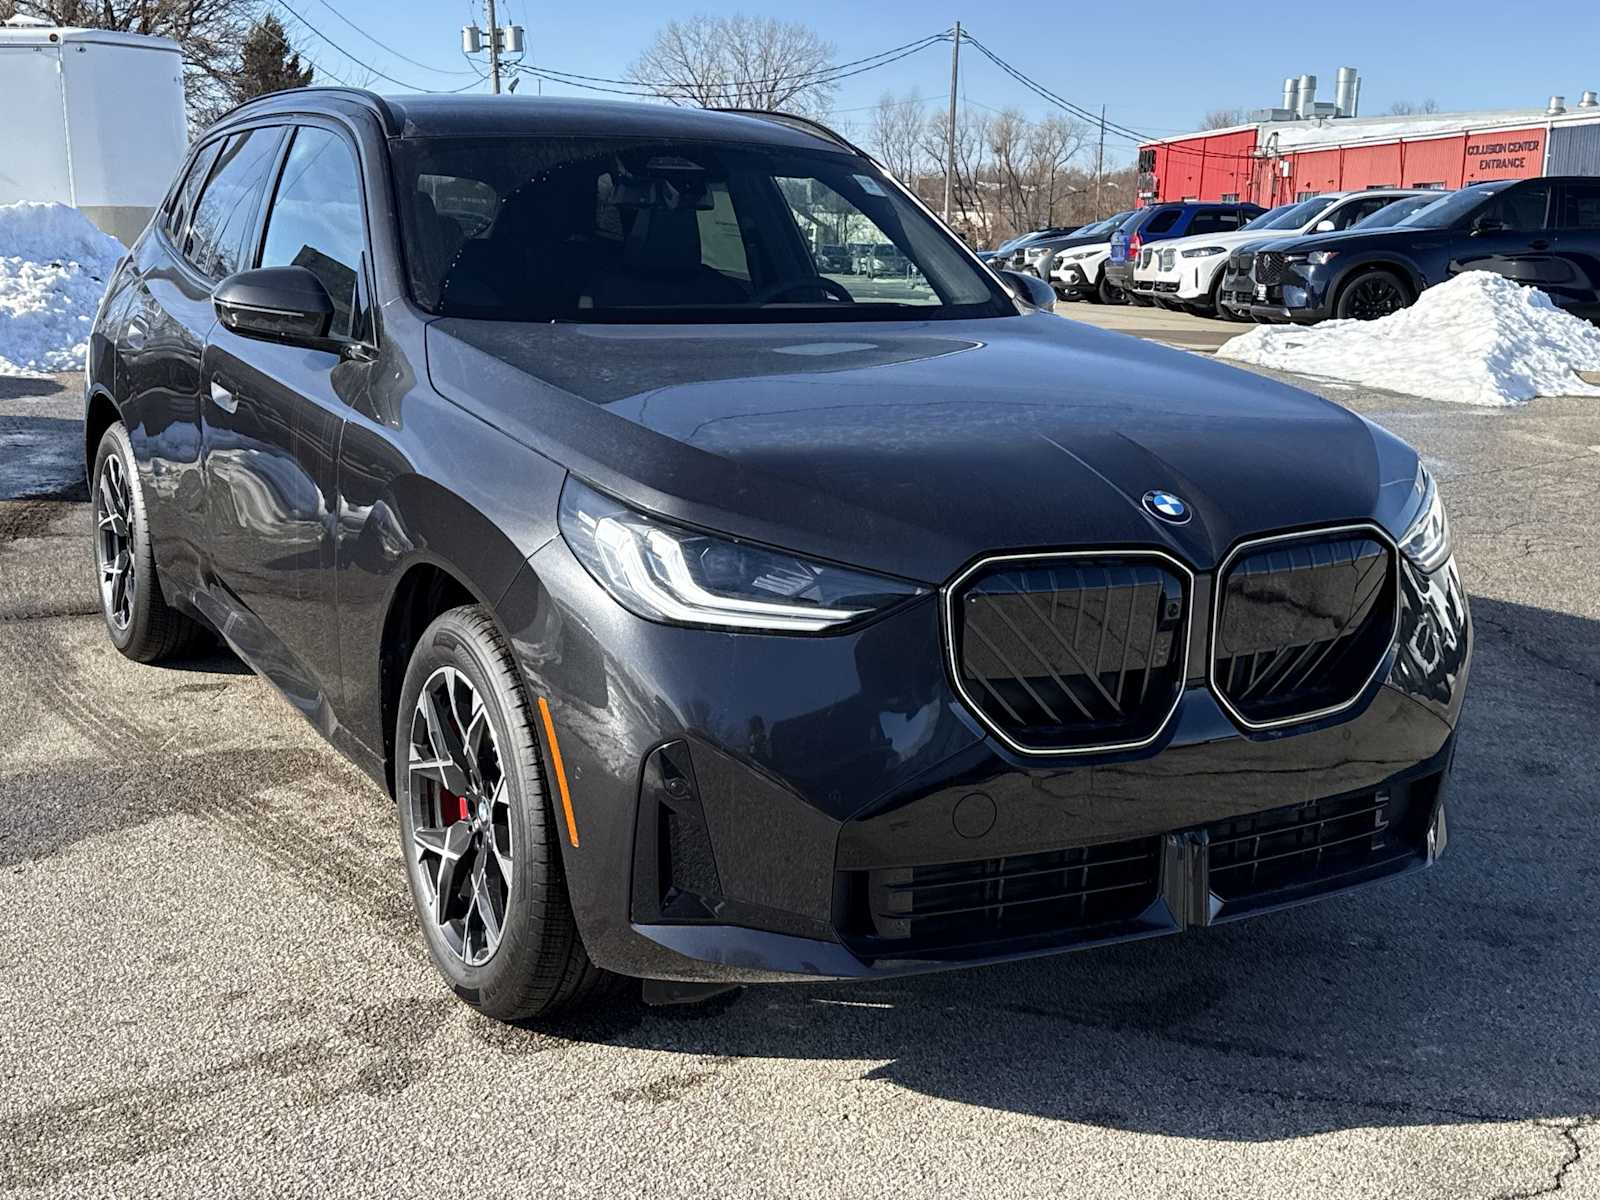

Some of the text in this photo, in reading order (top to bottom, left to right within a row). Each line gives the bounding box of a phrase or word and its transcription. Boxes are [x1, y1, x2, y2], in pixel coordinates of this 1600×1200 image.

[1467, 141, 1539, 155] COLLISION CENTER
[1479, 157, 1525, 170] ENTRANCE
